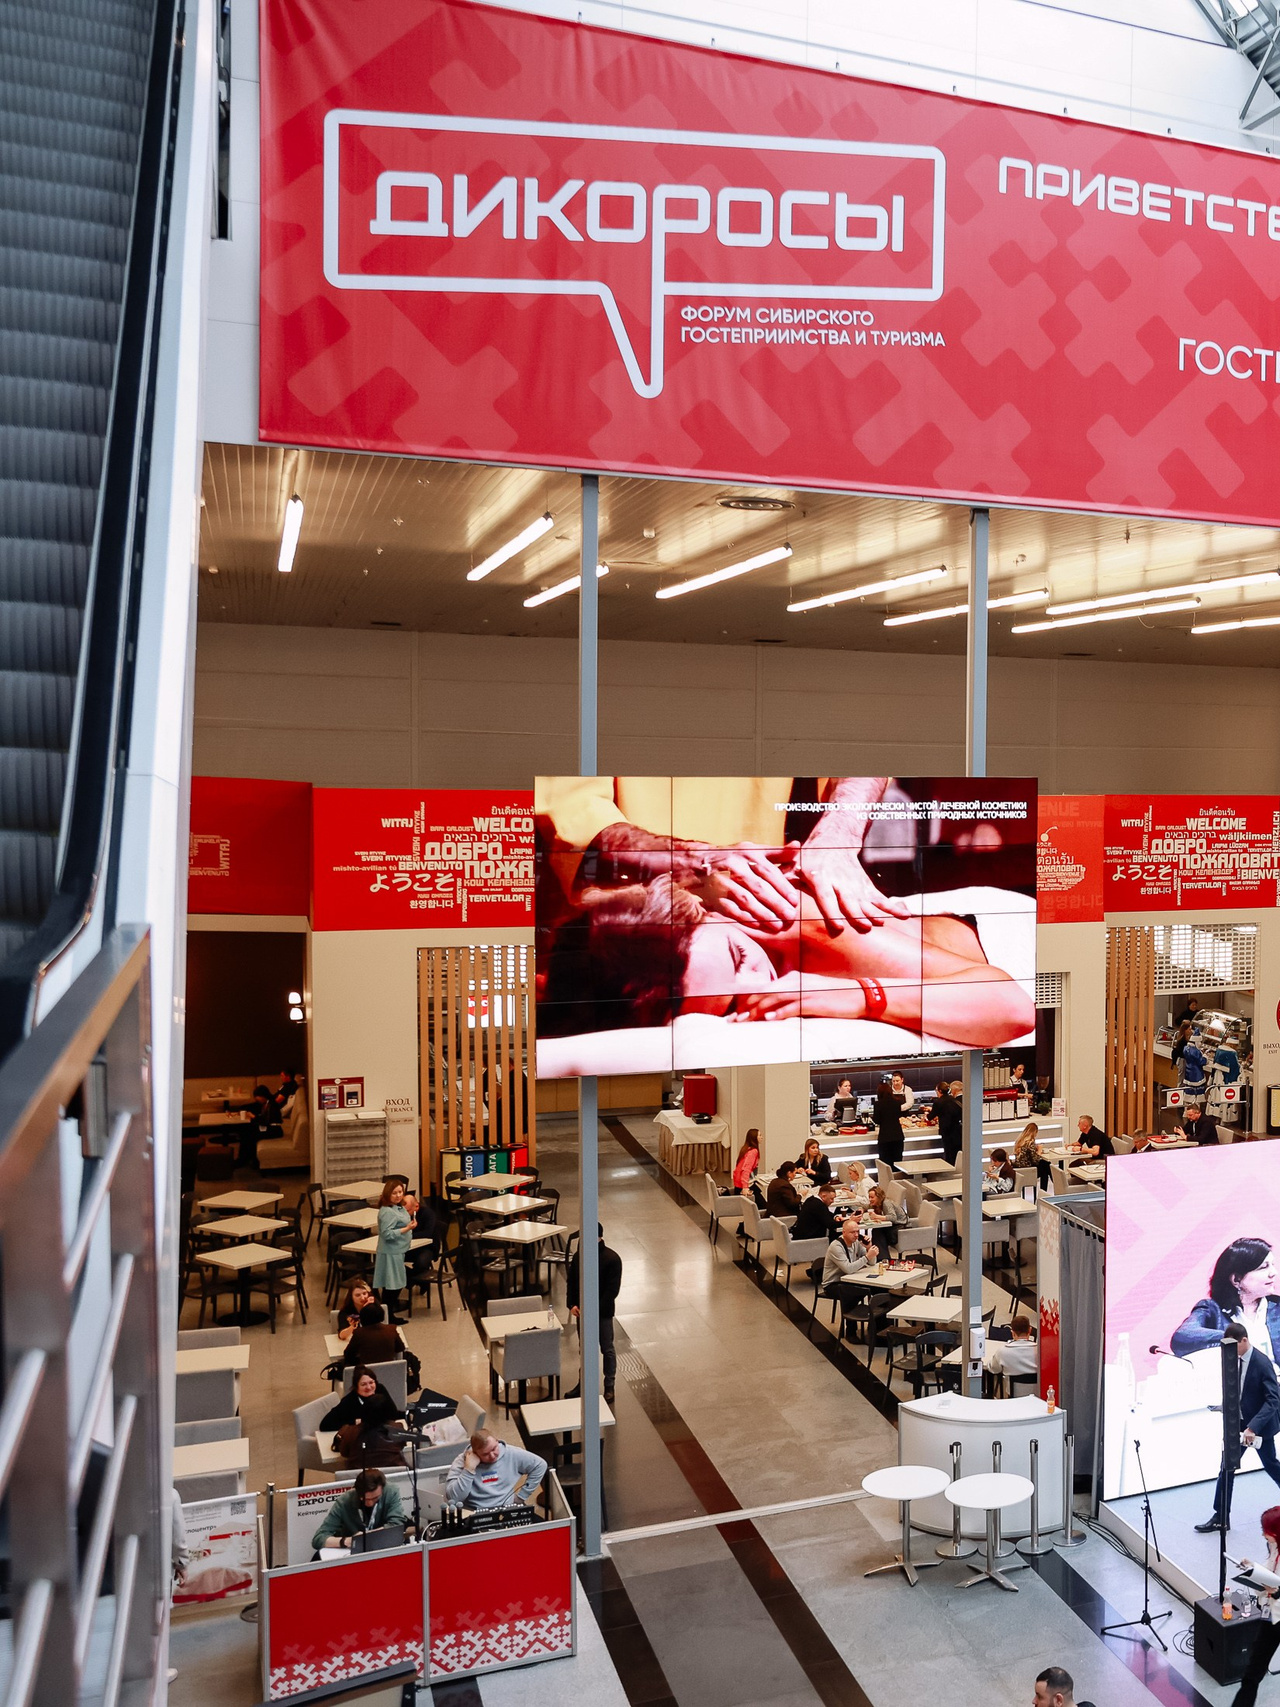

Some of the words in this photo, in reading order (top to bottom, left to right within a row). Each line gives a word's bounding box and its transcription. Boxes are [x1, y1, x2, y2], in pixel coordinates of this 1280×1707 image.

[370, 170, 904, 252] ДИКОРОСЫ
[680, 305, 752, 324] ФОРУМ
[756, 306, 874, 326] СИБИРСКОГО
[680, 326, 852, 346] ГОСТЕПРИИМСТВА
[855, 328, 867, 346] И
[871, 330, 946, 347] ТУРИЗМА
[774, 802, 840, 812] ПРОИЗВОДСТВО
[842, 802, 904, 812] ЭКОЛОГИЧЕСКИ
[906, 800, 937, 811] ЧИСТОЙ
[939, 800, 980, 810] ЛЕЧЕБНОЙ
[982, 801, 1027, 810] КОСМЕТИКИ
[856, 812, 868, 820] ИЗ
[869, 811, 926, 820] СОБСТВЕННЫХ
[928, 811, 976, 820] ПРИРОДНЫХ
[976, 810, 1027, 820] ИСТОЧНИКОВ
[381, 818, 413, 828] WITAJ
[1121, 819, 1143, 827] WITAJ
[1186, 818, 1246, 830] WELCOME
[220, 838, 230, 870] WITAJ
[424, 842, 502, 860] ДОБРО
[1151, 839, 1206, 854] ДОБРО
[398, 861, 463, 870] BENVENUTO
[464, 860, 534, 878] ПОЖА
[1112, 865, 1172, 881] ようこそ
[370, 872, 454, 892] ようこそ
[410, 900, 454, 908] 환영합니다
[298, 1497, 324, 1506] EXPO
